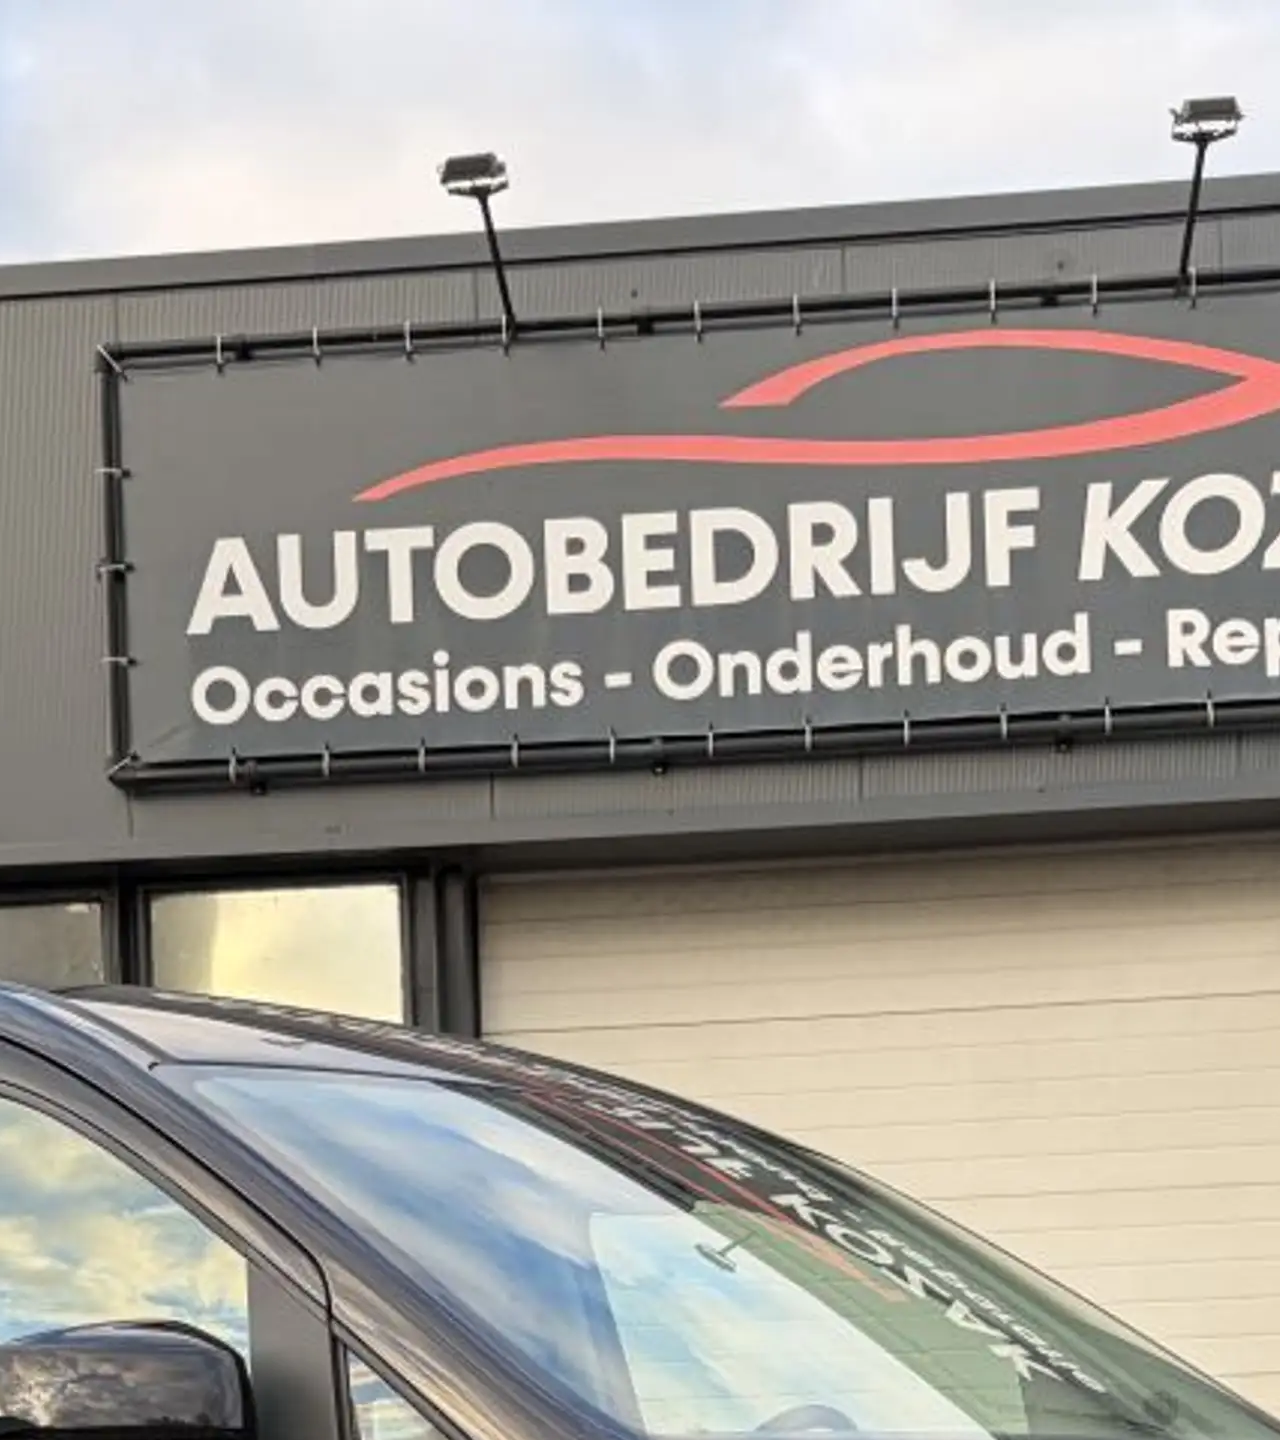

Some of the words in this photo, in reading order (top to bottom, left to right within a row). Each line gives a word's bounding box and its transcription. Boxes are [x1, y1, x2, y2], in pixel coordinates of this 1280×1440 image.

[187, 487, 1040, 636] AUTOBEDRIJF
[191, 650, 585, 726] Occasions
[605, 672, 631, 691] -
[654, 612, 1092, 702] Onderhoud
[1114, 638, 1143, 656] -
